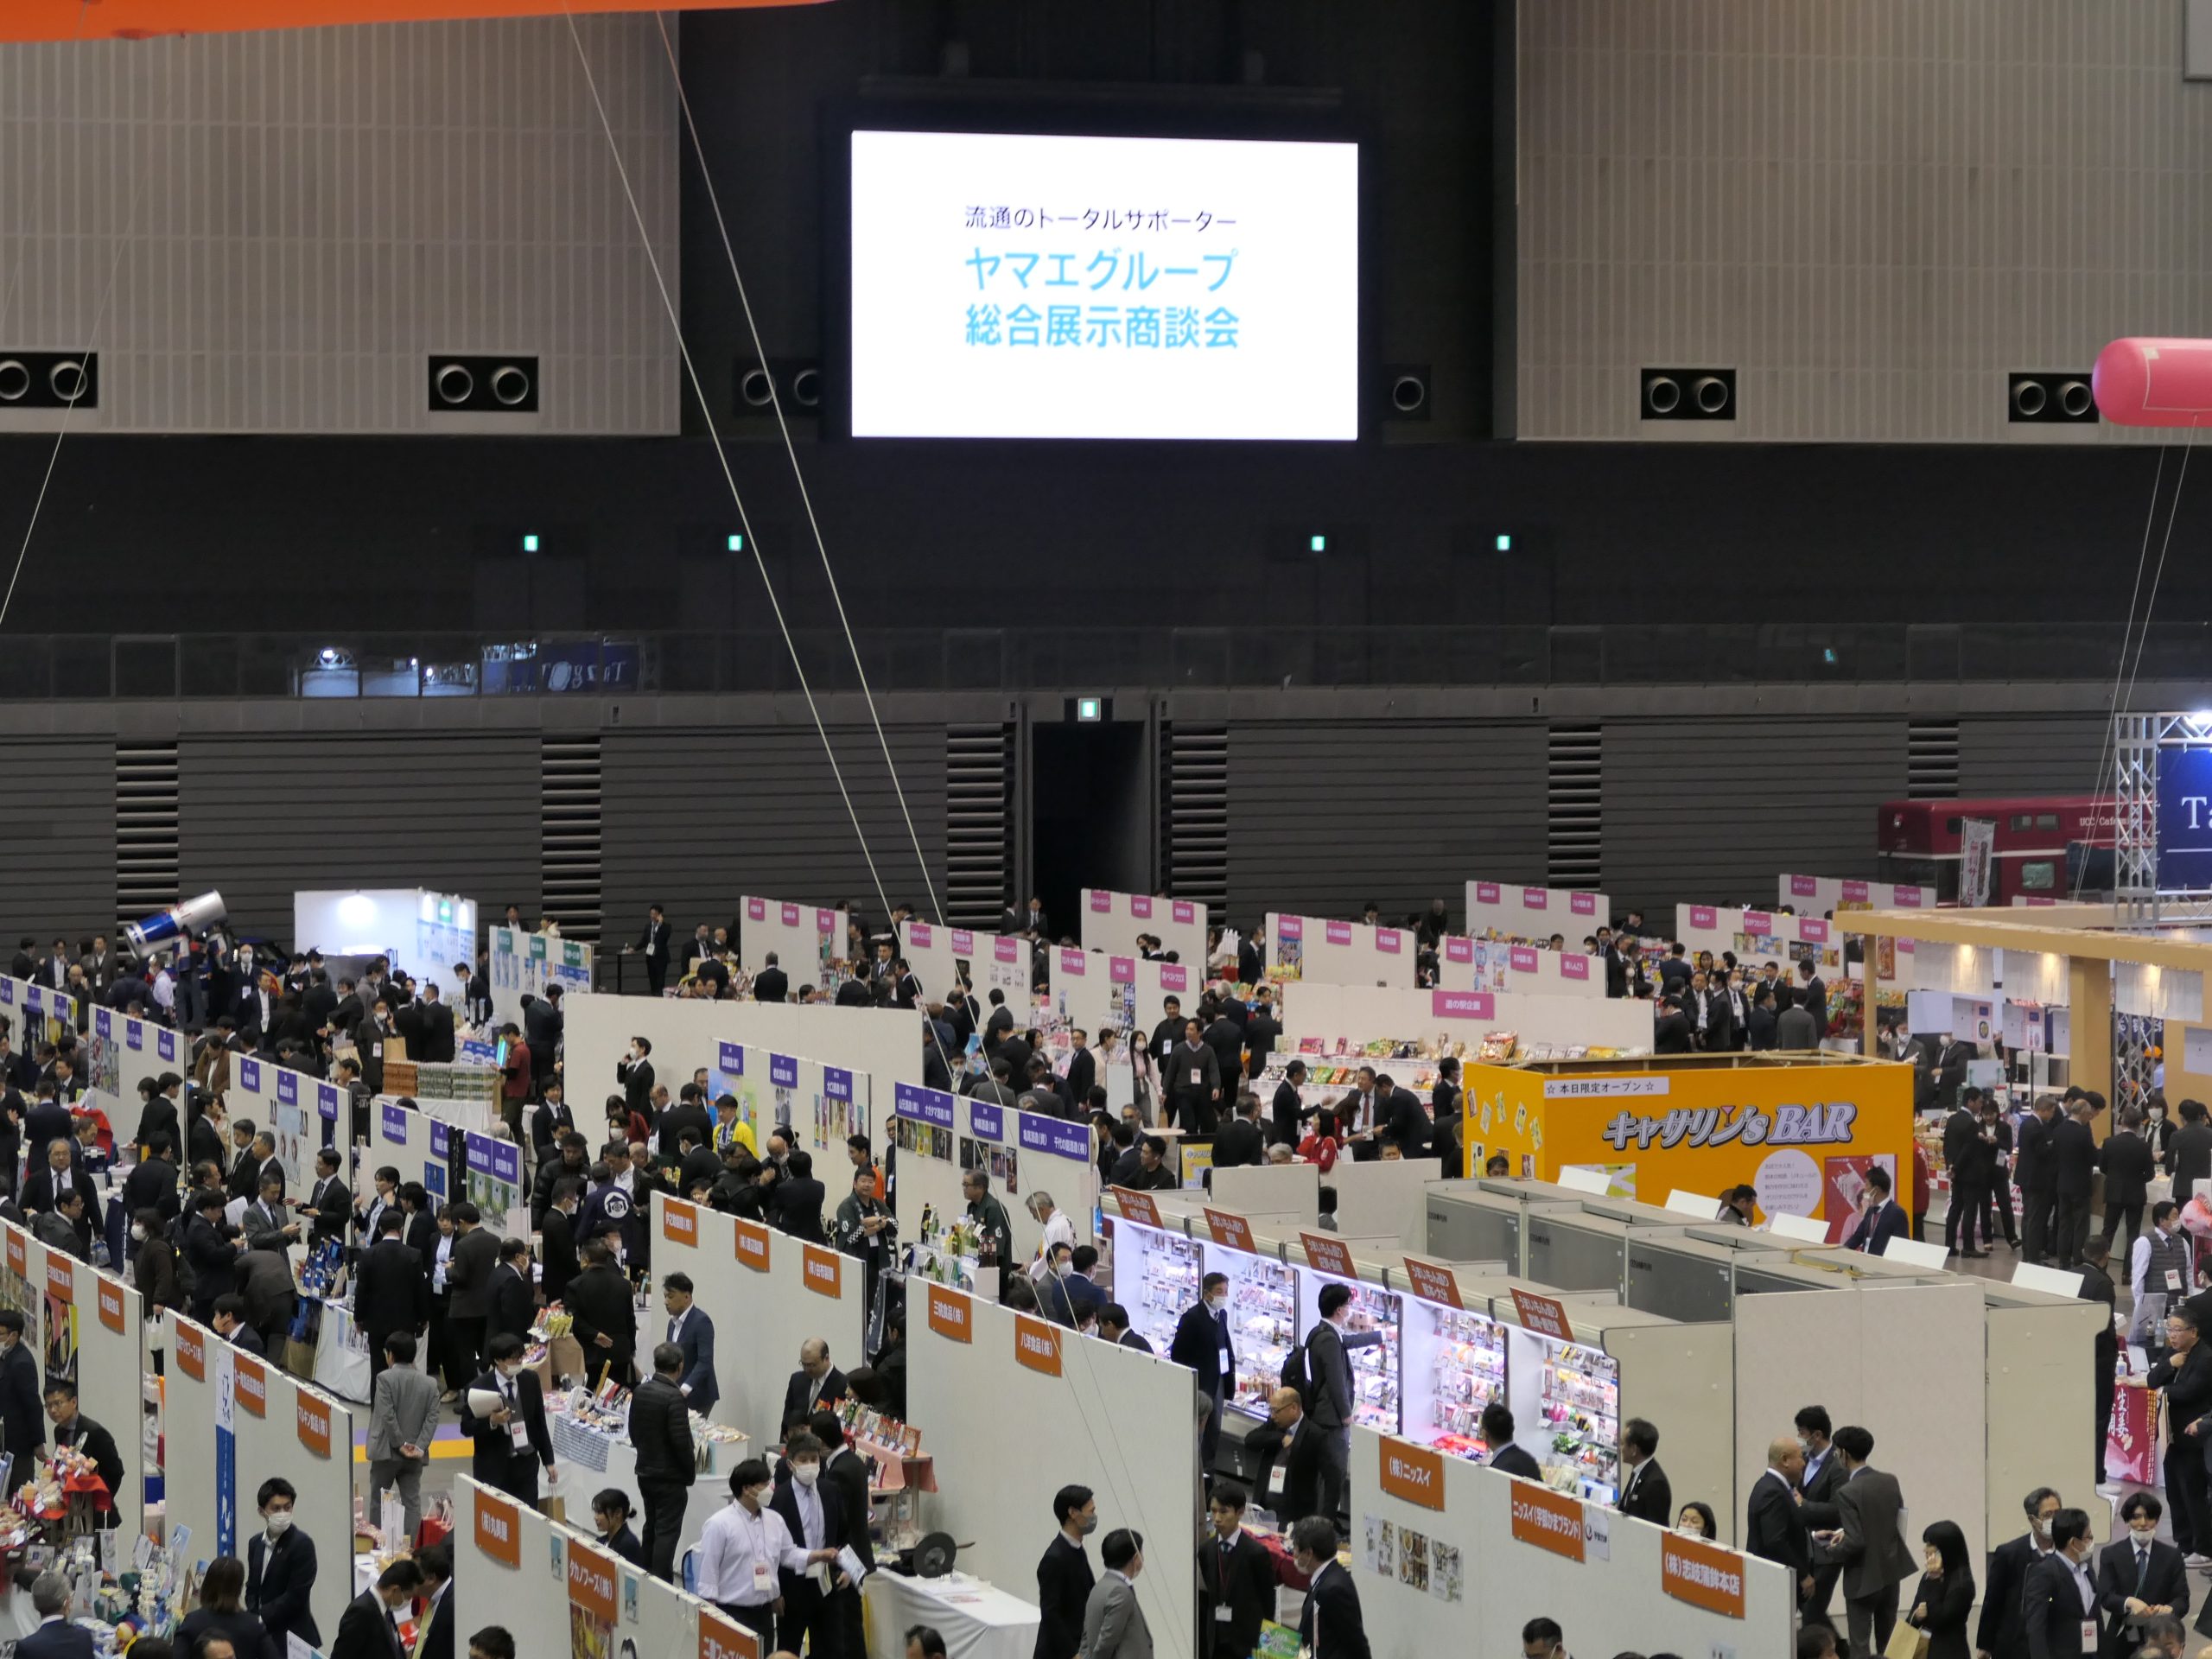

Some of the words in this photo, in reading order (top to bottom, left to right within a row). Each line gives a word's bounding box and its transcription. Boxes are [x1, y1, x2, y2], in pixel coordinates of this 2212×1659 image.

[965, 206, 1236, 232] 流通のトータルサポーター
[965, 247, 1239, 292] ヤマエグループ
[965, 303, 1239, 349] 総合展示商談会
[2080, 817, 2095, 827] UCC
[1446, 999, 1481, 1011] 道の駅企画
[1560, 1081, 1642, 1094] 本日限定オープン
[1767, 1103, 1857, 1146] BAR
[1020, 1332, 1052, 1357] 八洋食品(株)
[1389, 1456, 1432, 1487] (株)ニッスイ
[480, 1510, 509, 1543] (株)丸美屋
[569, 1557, 613, 1602] タカノフーズ(株)
